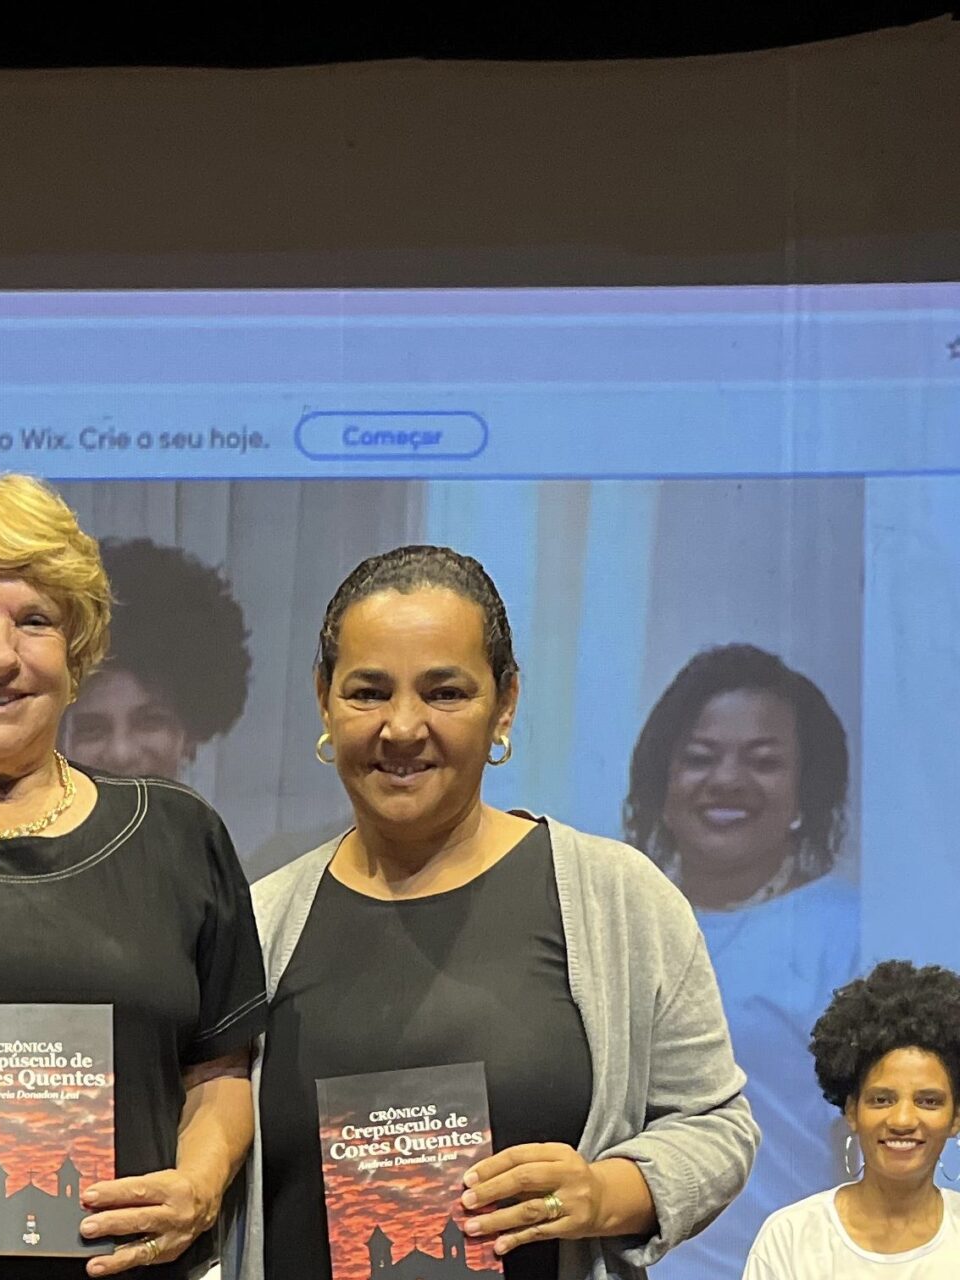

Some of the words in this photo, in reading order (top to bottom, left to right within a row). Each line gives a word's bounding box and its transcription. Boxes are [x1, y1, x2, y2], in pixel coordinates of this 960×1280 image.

[20, 428, 72, 451] Wix.
[78, 427, 131, 451] Crie
[136, 431, 152, 451] o
[158, 432, 202, 450] seu
[210, 426, 270, 453] hoje.
[342, 425, 443, 450] Começar
[70, 1052, 93, 1069] de
[18, 1069, 106, 1090] Quentes
[369, 1104, 437, 1122] CRÔNICAS
[341, 1116, 442, 1141] Crepúsculo
[445, 1113, 468, 1129] de
[330, 1141, 391, 1160] Cores
[394, 1131, 483, 1156] Quentes
